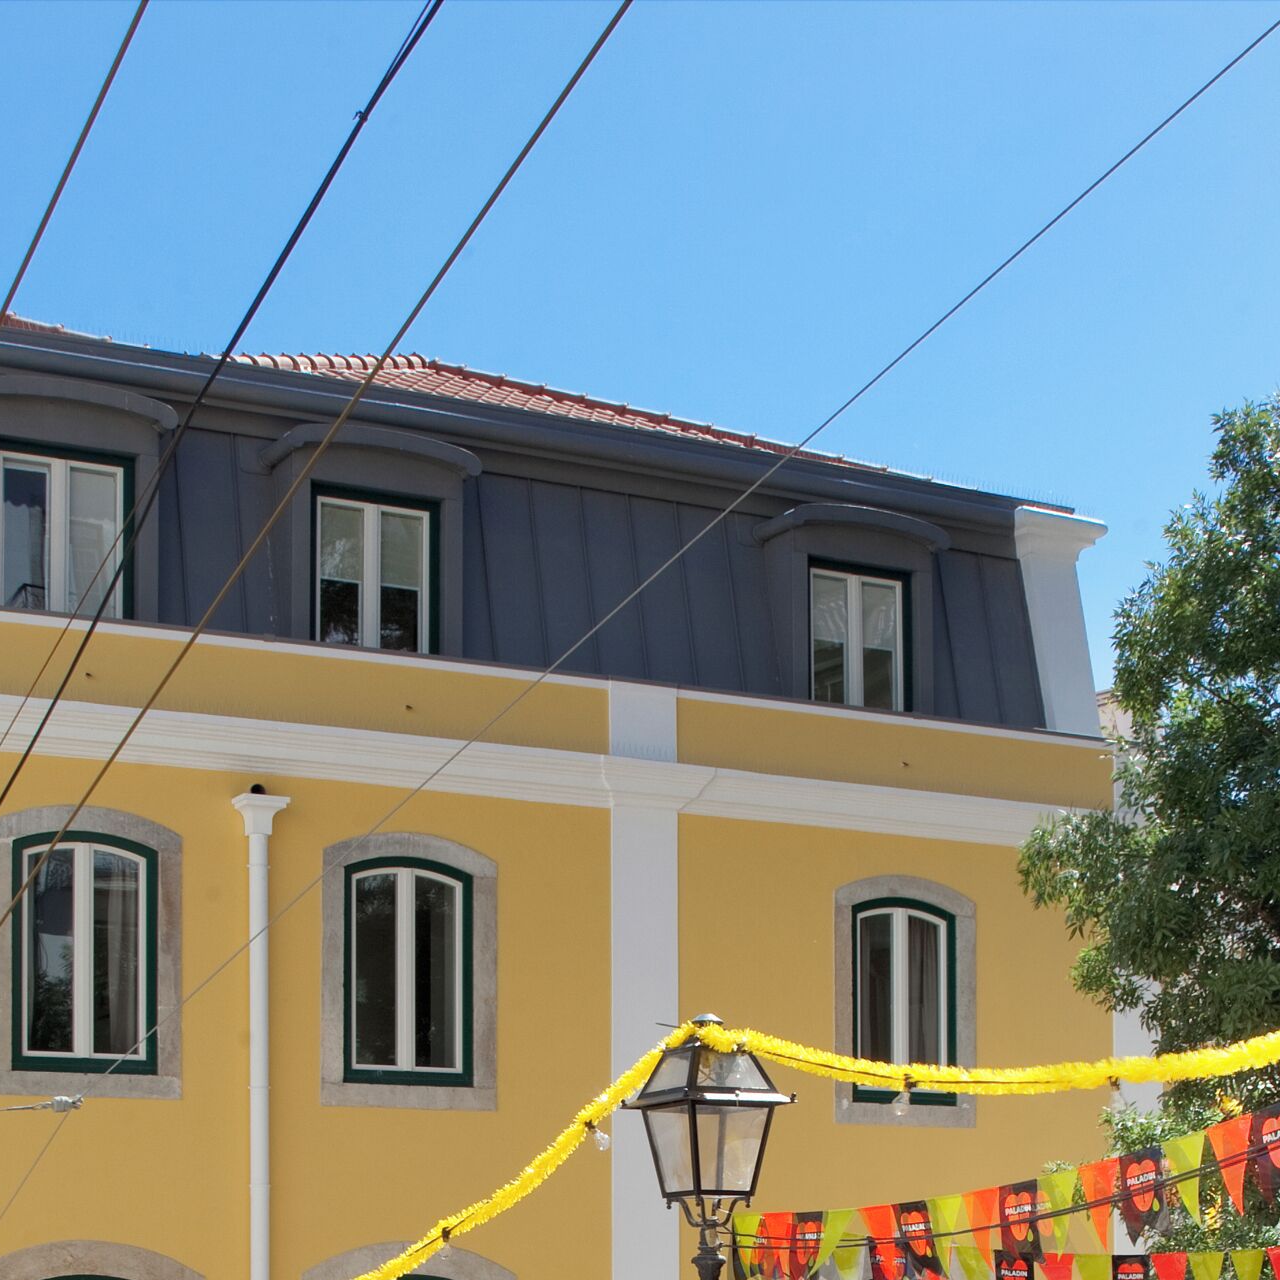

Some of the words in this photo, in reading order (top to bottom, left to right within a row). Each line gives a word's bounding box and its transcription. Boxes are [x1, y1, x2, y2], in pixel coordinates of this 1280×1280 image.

[1126, 1171, 1157, 1187] PALADIN
[1004, 1203, 1033, 1216] PALADIN
[1001, 1268, 1028, 1278] PALADIN
[1117, 1273, 1144, 1280] PALADIN
